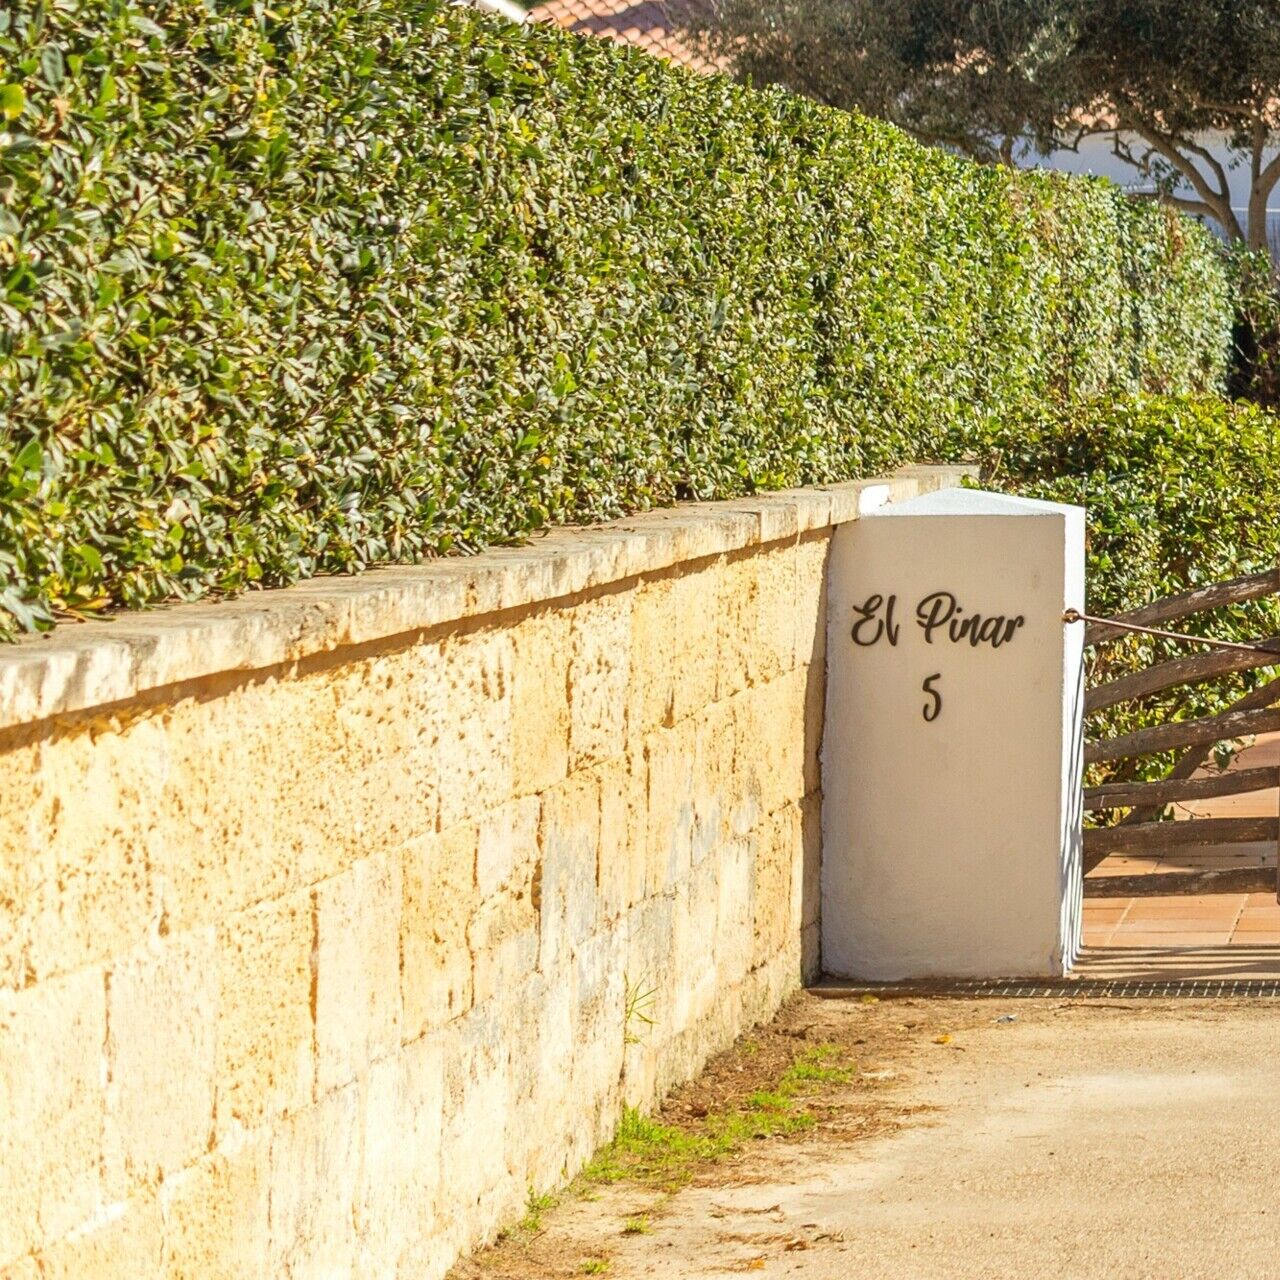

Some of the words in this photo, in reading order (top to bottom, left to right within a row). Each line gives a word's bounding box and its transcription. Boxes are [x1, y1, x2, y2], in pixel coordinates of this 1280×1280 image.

[852, 594, 900, 646] El
[916, 592, 1025, 648] Pinar
[922, 673, 942, 722] 5
